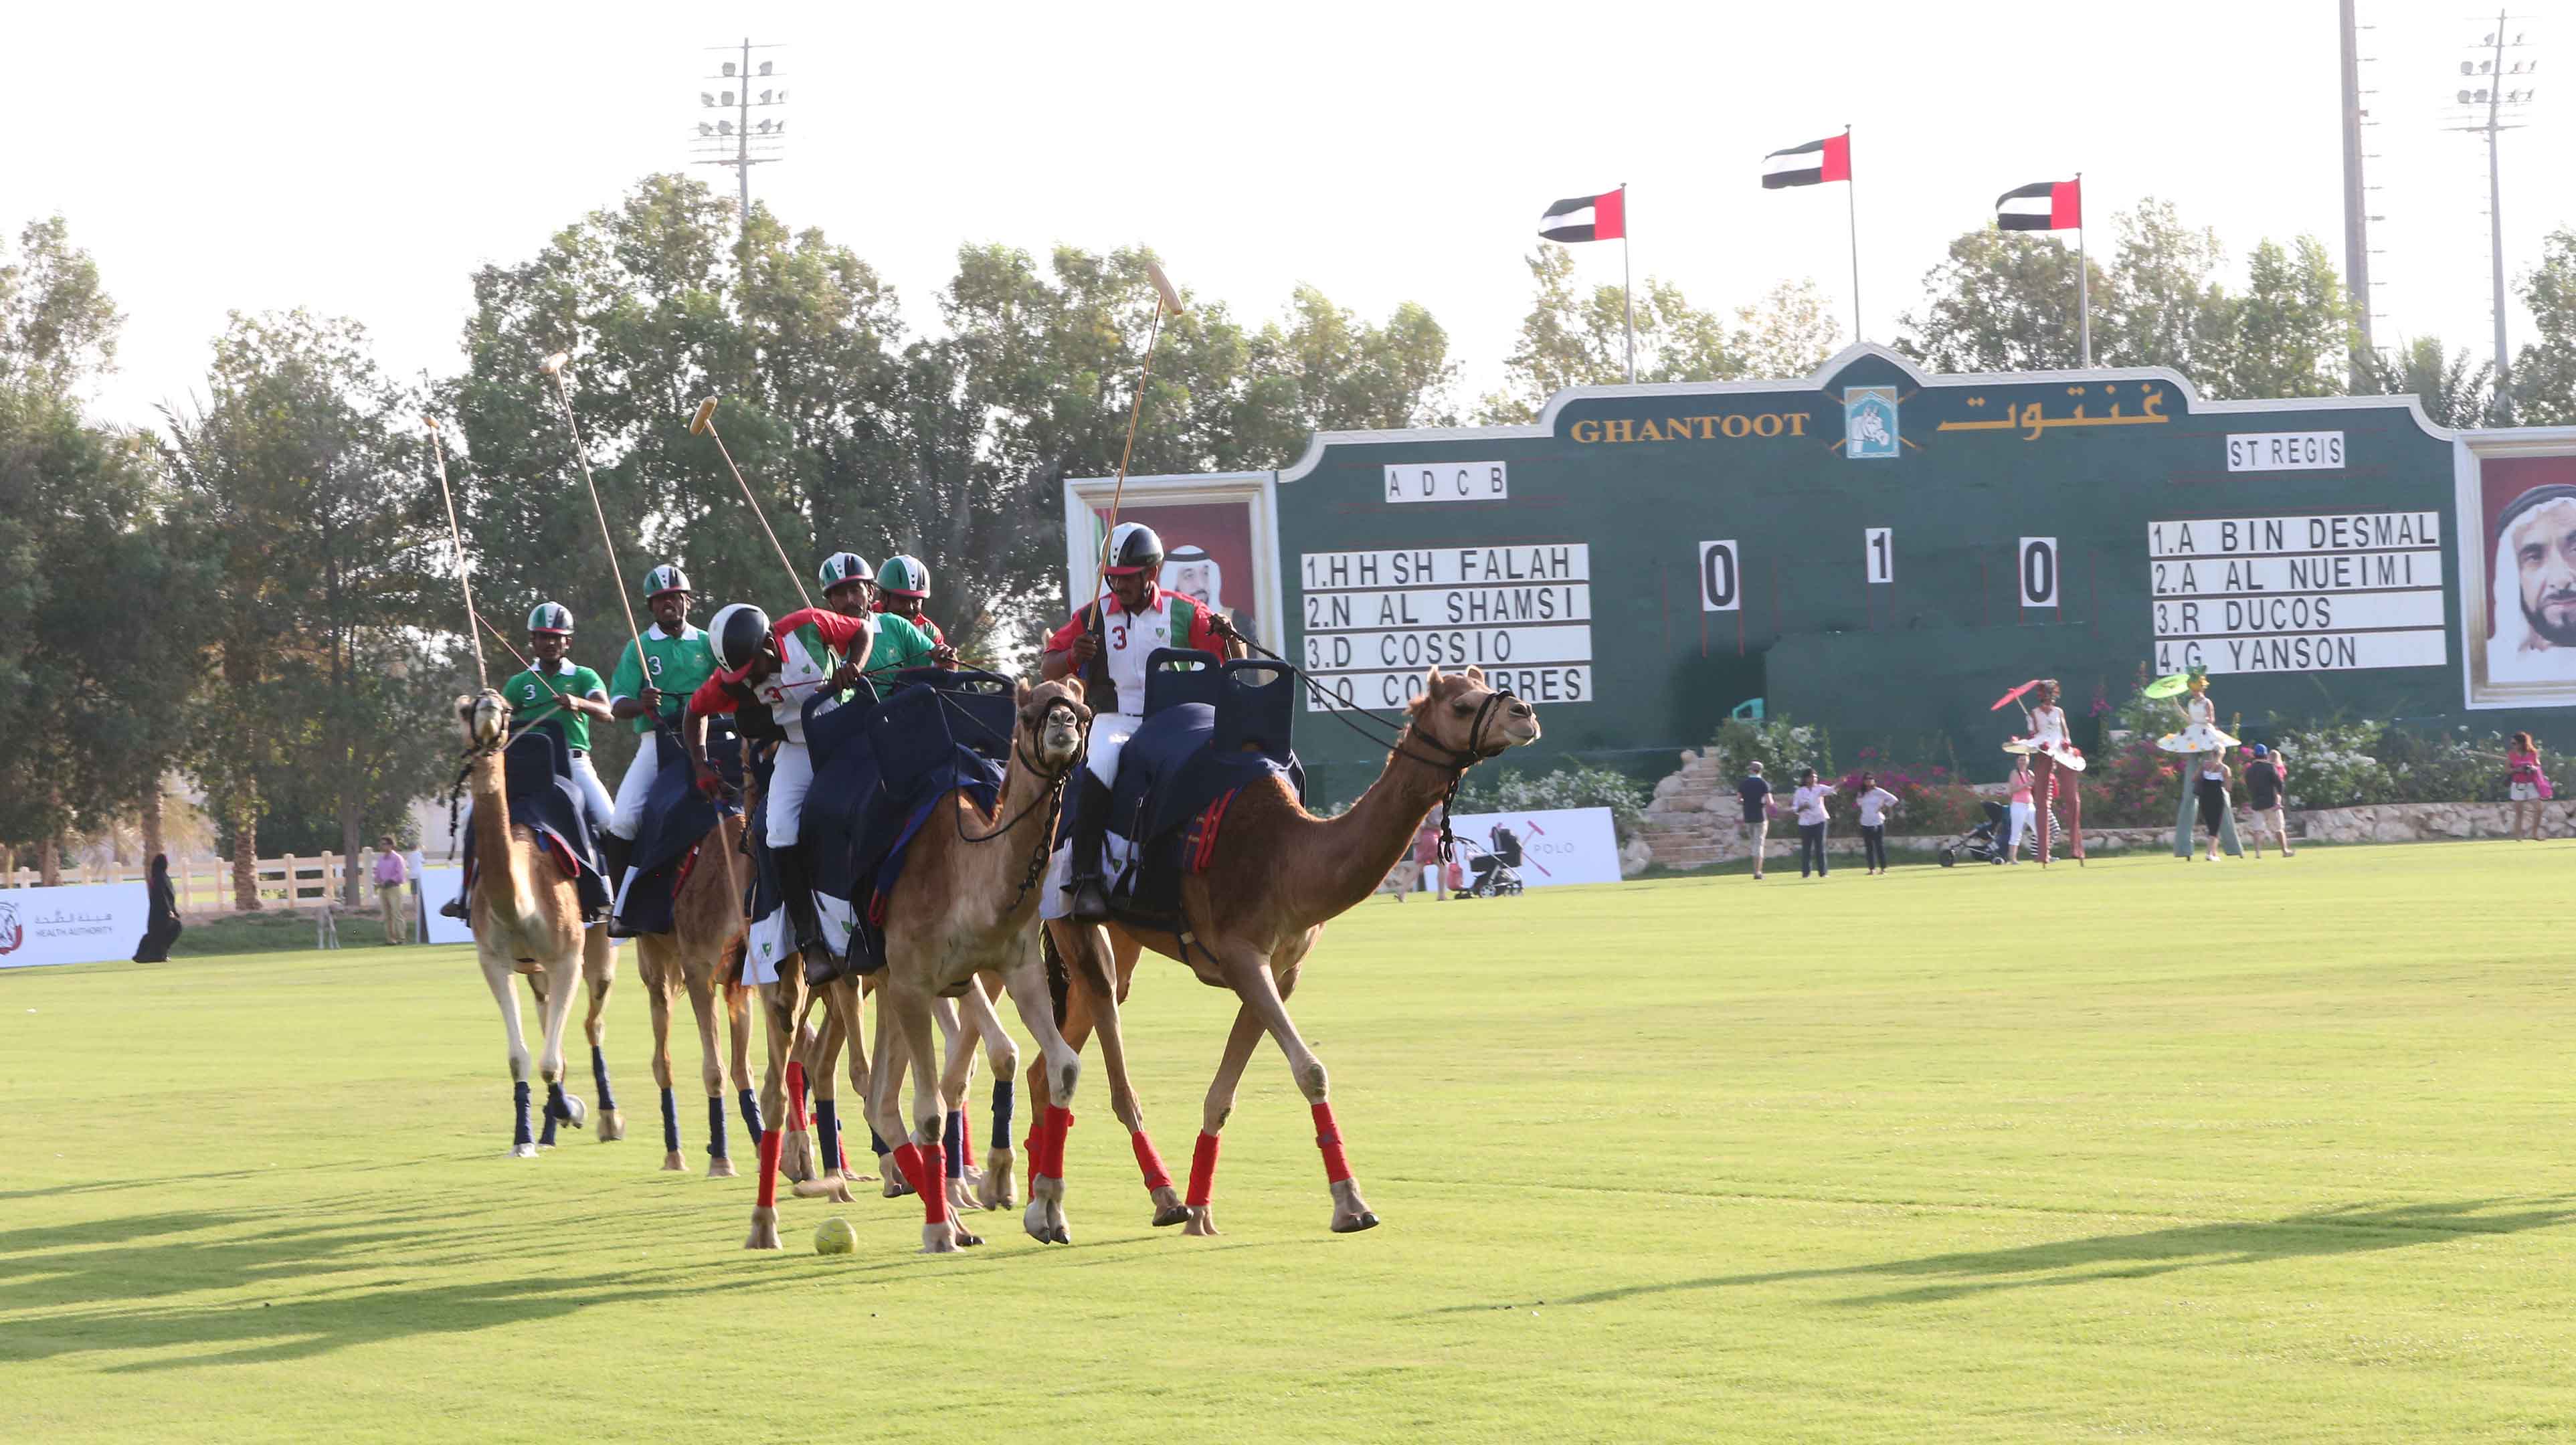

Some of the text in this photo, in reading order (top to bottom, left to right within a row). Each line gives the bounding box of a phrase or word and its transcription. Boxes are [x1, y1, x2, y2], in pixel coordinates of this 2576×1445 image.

[1570, 412, 1810, 444] GHANTOOT
[1936, 383, 2169, 441] غنتوت
[2230, 437, 2341, 466] ST REGIS
[2221, 519, 2284, 553] BIN
[2309, 514, 2437, 549] DESMAL
[1461, 547, 1570, 581] FALAH
[1871, 531, 1888, 580] 1
[2023, 541, 2053, 603] 0
[2225, 560, 2264, 591] AL
[2290, 555, 2412, 589] NUEIMI
[1705, 543, 1736, 607] 0
[1379, 593, 1419, 626] AL
[1447, 587, 1573, 623] SHAMSI
[2226, 597, 2332, 632] DUCOS
[1112, 625, 1127, 650] 3
[1381, 630, 1511, 666] COSSIO
[2228, 636, 2357, 671] YANSON
[648, 656, 663, 676] 3
[523, 684, 537, 700] 3
[1383, 668, 1582, 707] COBRES
[1535, 843, 1574, 854] POLO
[35, 926, 112, 937] HEALTH AUTHORITY
